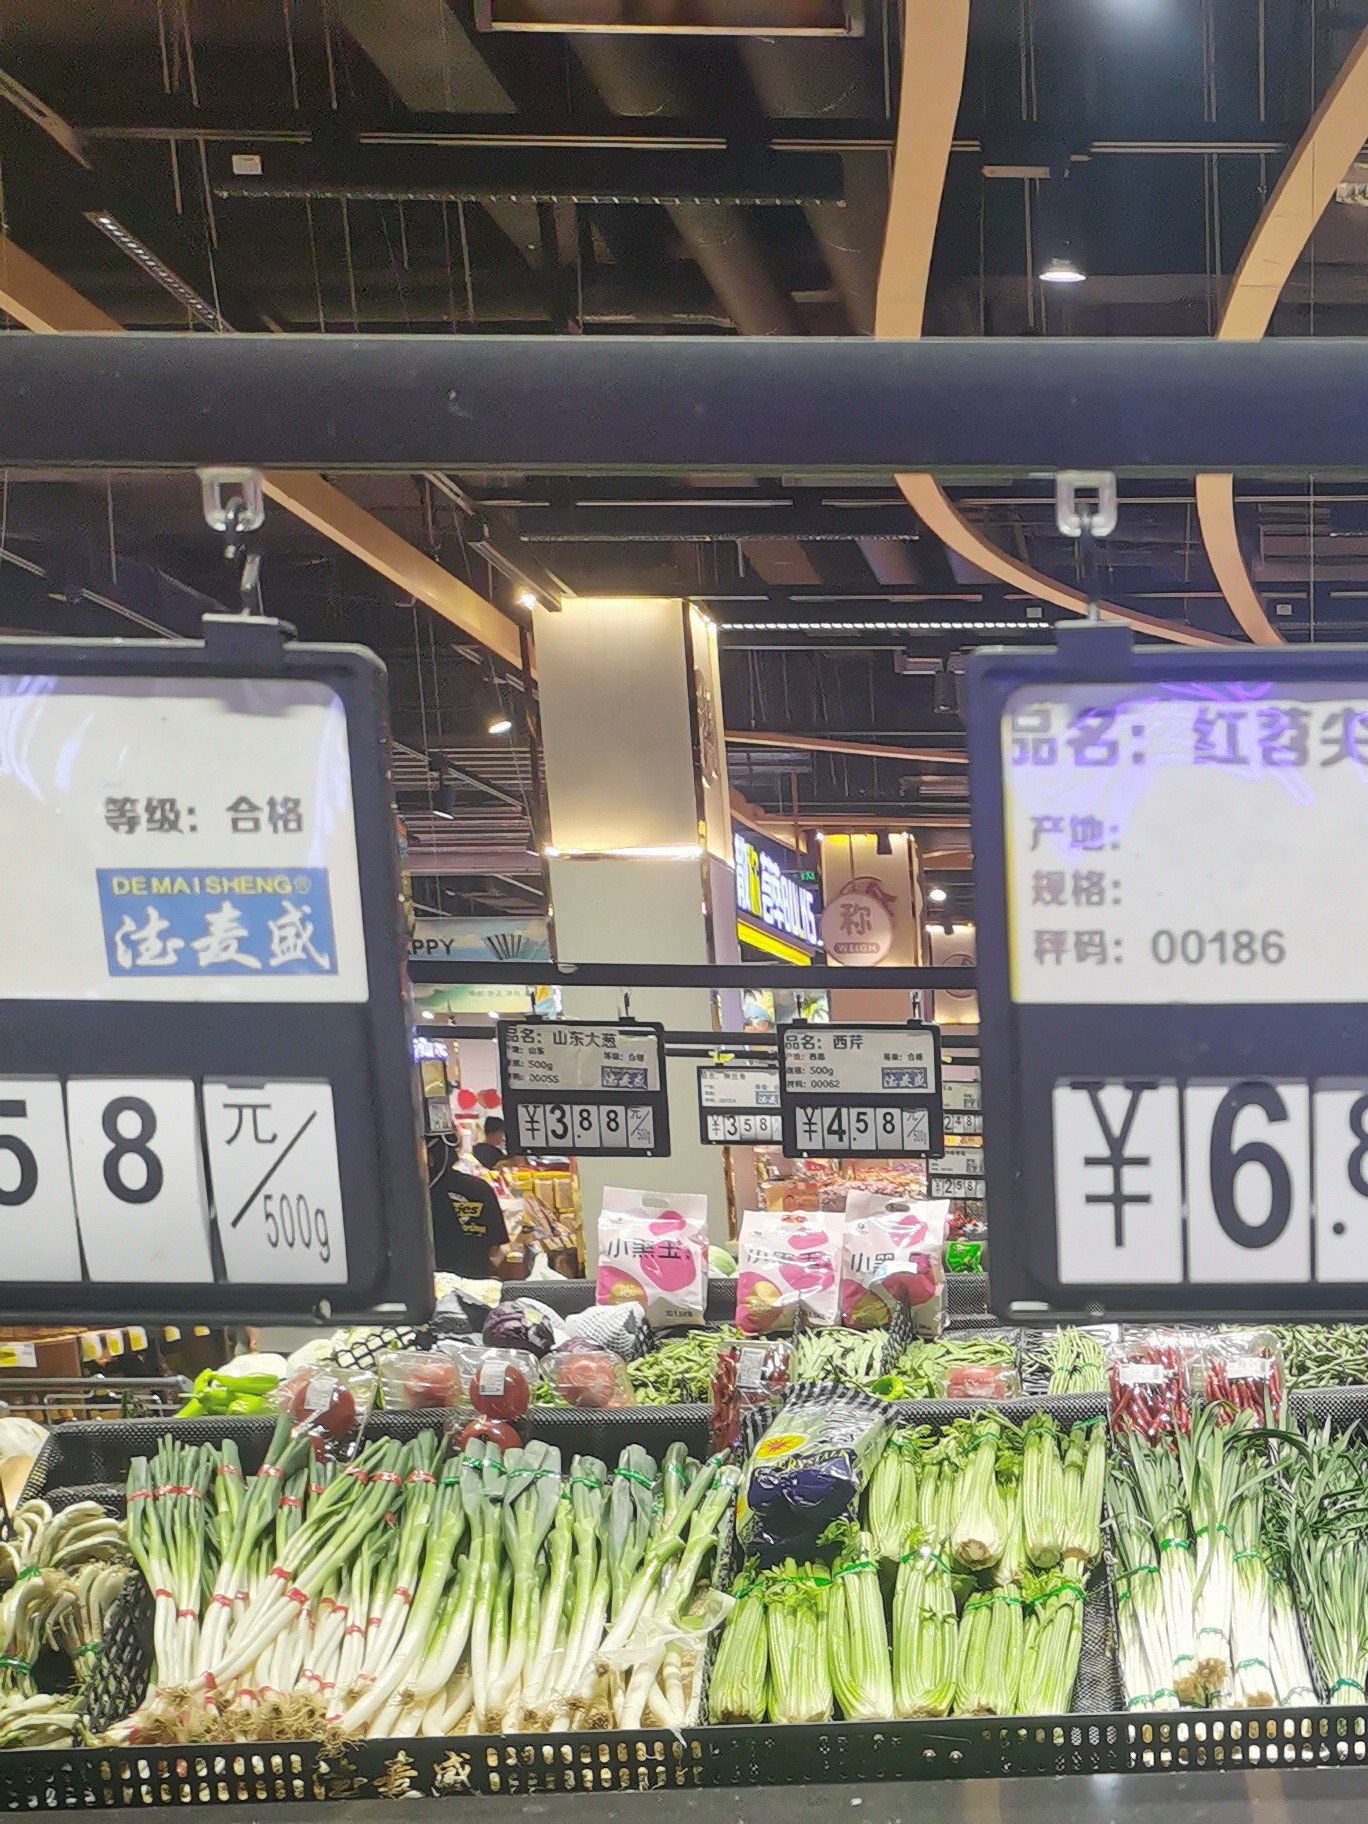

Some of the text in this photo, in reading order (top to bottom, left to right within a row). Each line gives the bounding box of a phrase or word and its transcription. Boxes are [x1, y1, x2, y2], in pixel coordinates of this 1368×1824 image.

[1011, 706, 1147, 768] 品名：
[104, 795, 304, 835] 等级： 合格
[1029, 815, 1122, 852] 产地：
[1031, 870, 1122, 907] 规格：
[408, 938, 455, 956] PPY
[837, 943, 877, 953] WEIGH
[1151, 929, 1287, 966] 00186
[552, 1030, 617, 1048] 山东大葱
[833, 1034, 864, 1050] 西芹
[528, 1060, 553, 1071] 500g
[809, 1067, 834, 1076] 500g
[810, 1080, 841, 1089] 00062
